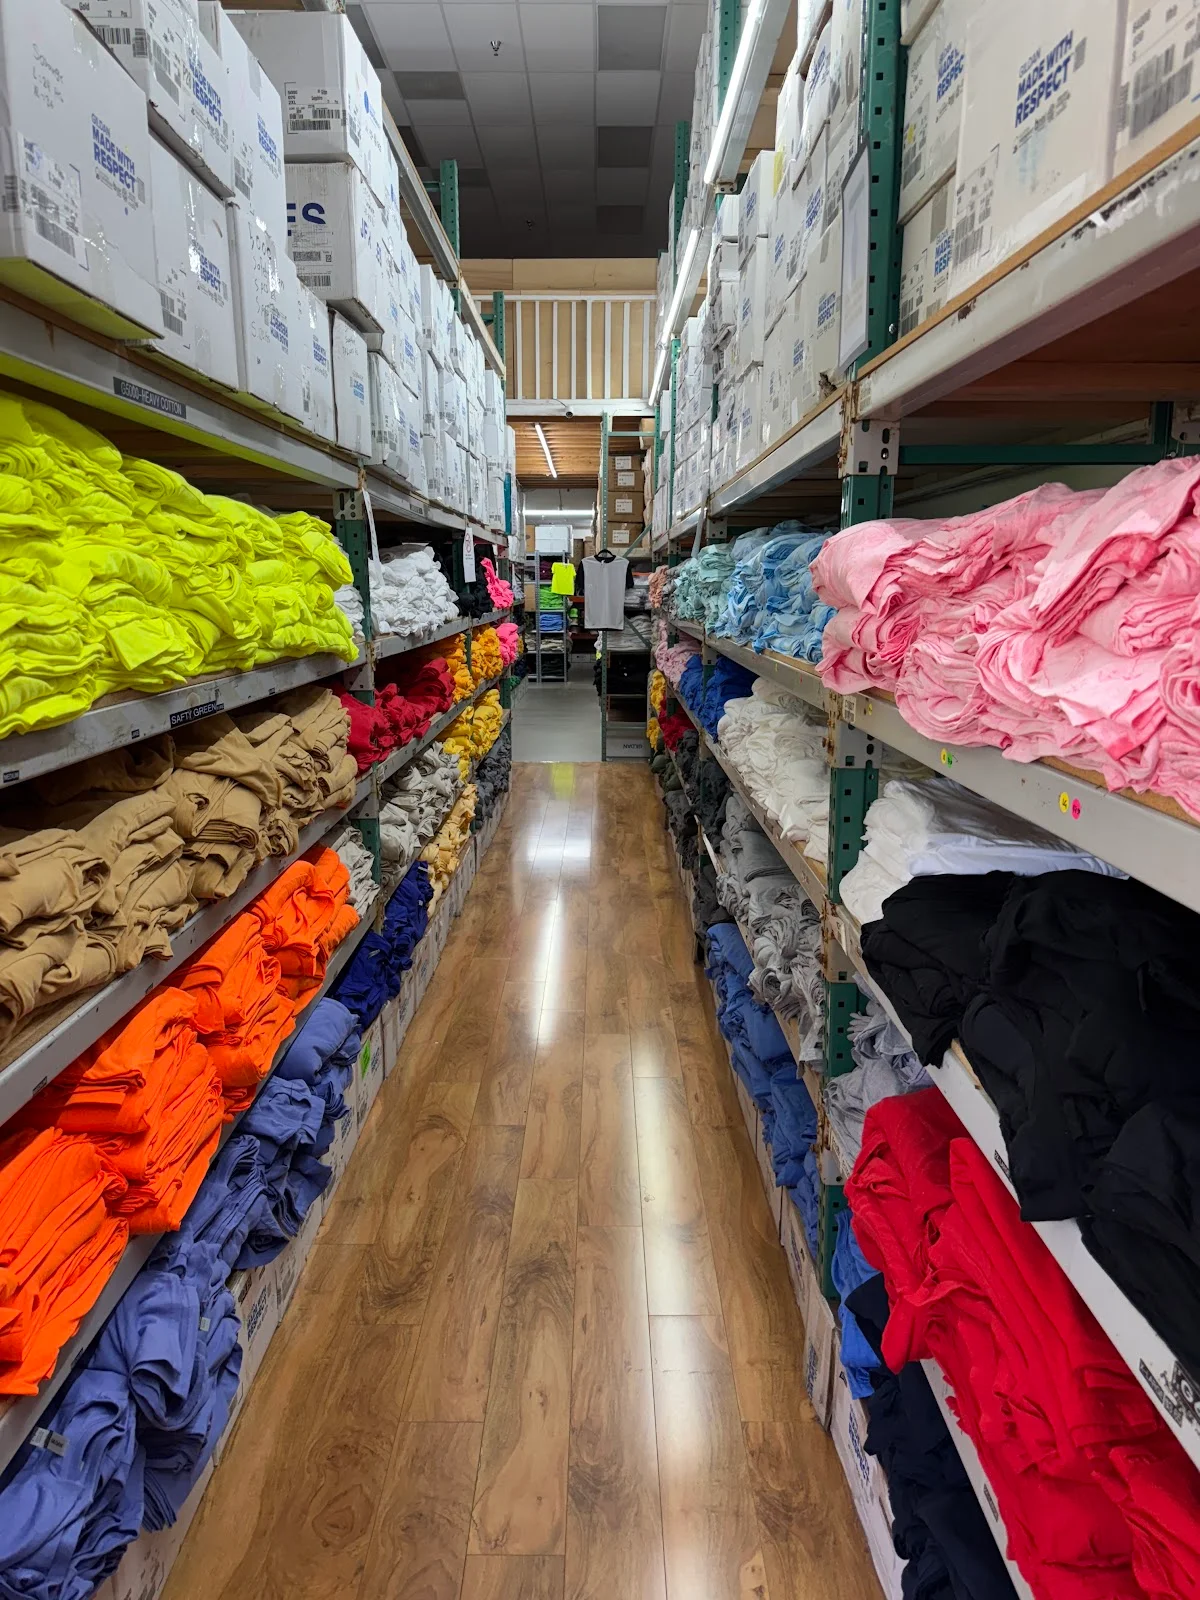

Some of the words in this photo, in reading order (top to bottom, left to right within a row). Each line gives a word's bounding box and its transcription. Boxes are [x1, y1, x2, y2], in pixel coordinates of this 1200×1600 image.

[1017, 58, 1045, 101] MADE
[1046, 29, 1074, 72] WITH
[1019, 46, 1041, 78] GILDAN
[207, 81, 221, 109] WITH
[1014, 55, 1071, 129] RESPECT
[92, 124, 115, 157] MADE
[116, 147, 135, 175] WITH
[93, 142, 136, 193] RESPECT
[935, 235, 951, 260] MADE
[160, 398, 182, 415] COTTON
[171, 709, 192, 725] SAFTY
[193, 703, 216, 718] GREEN
